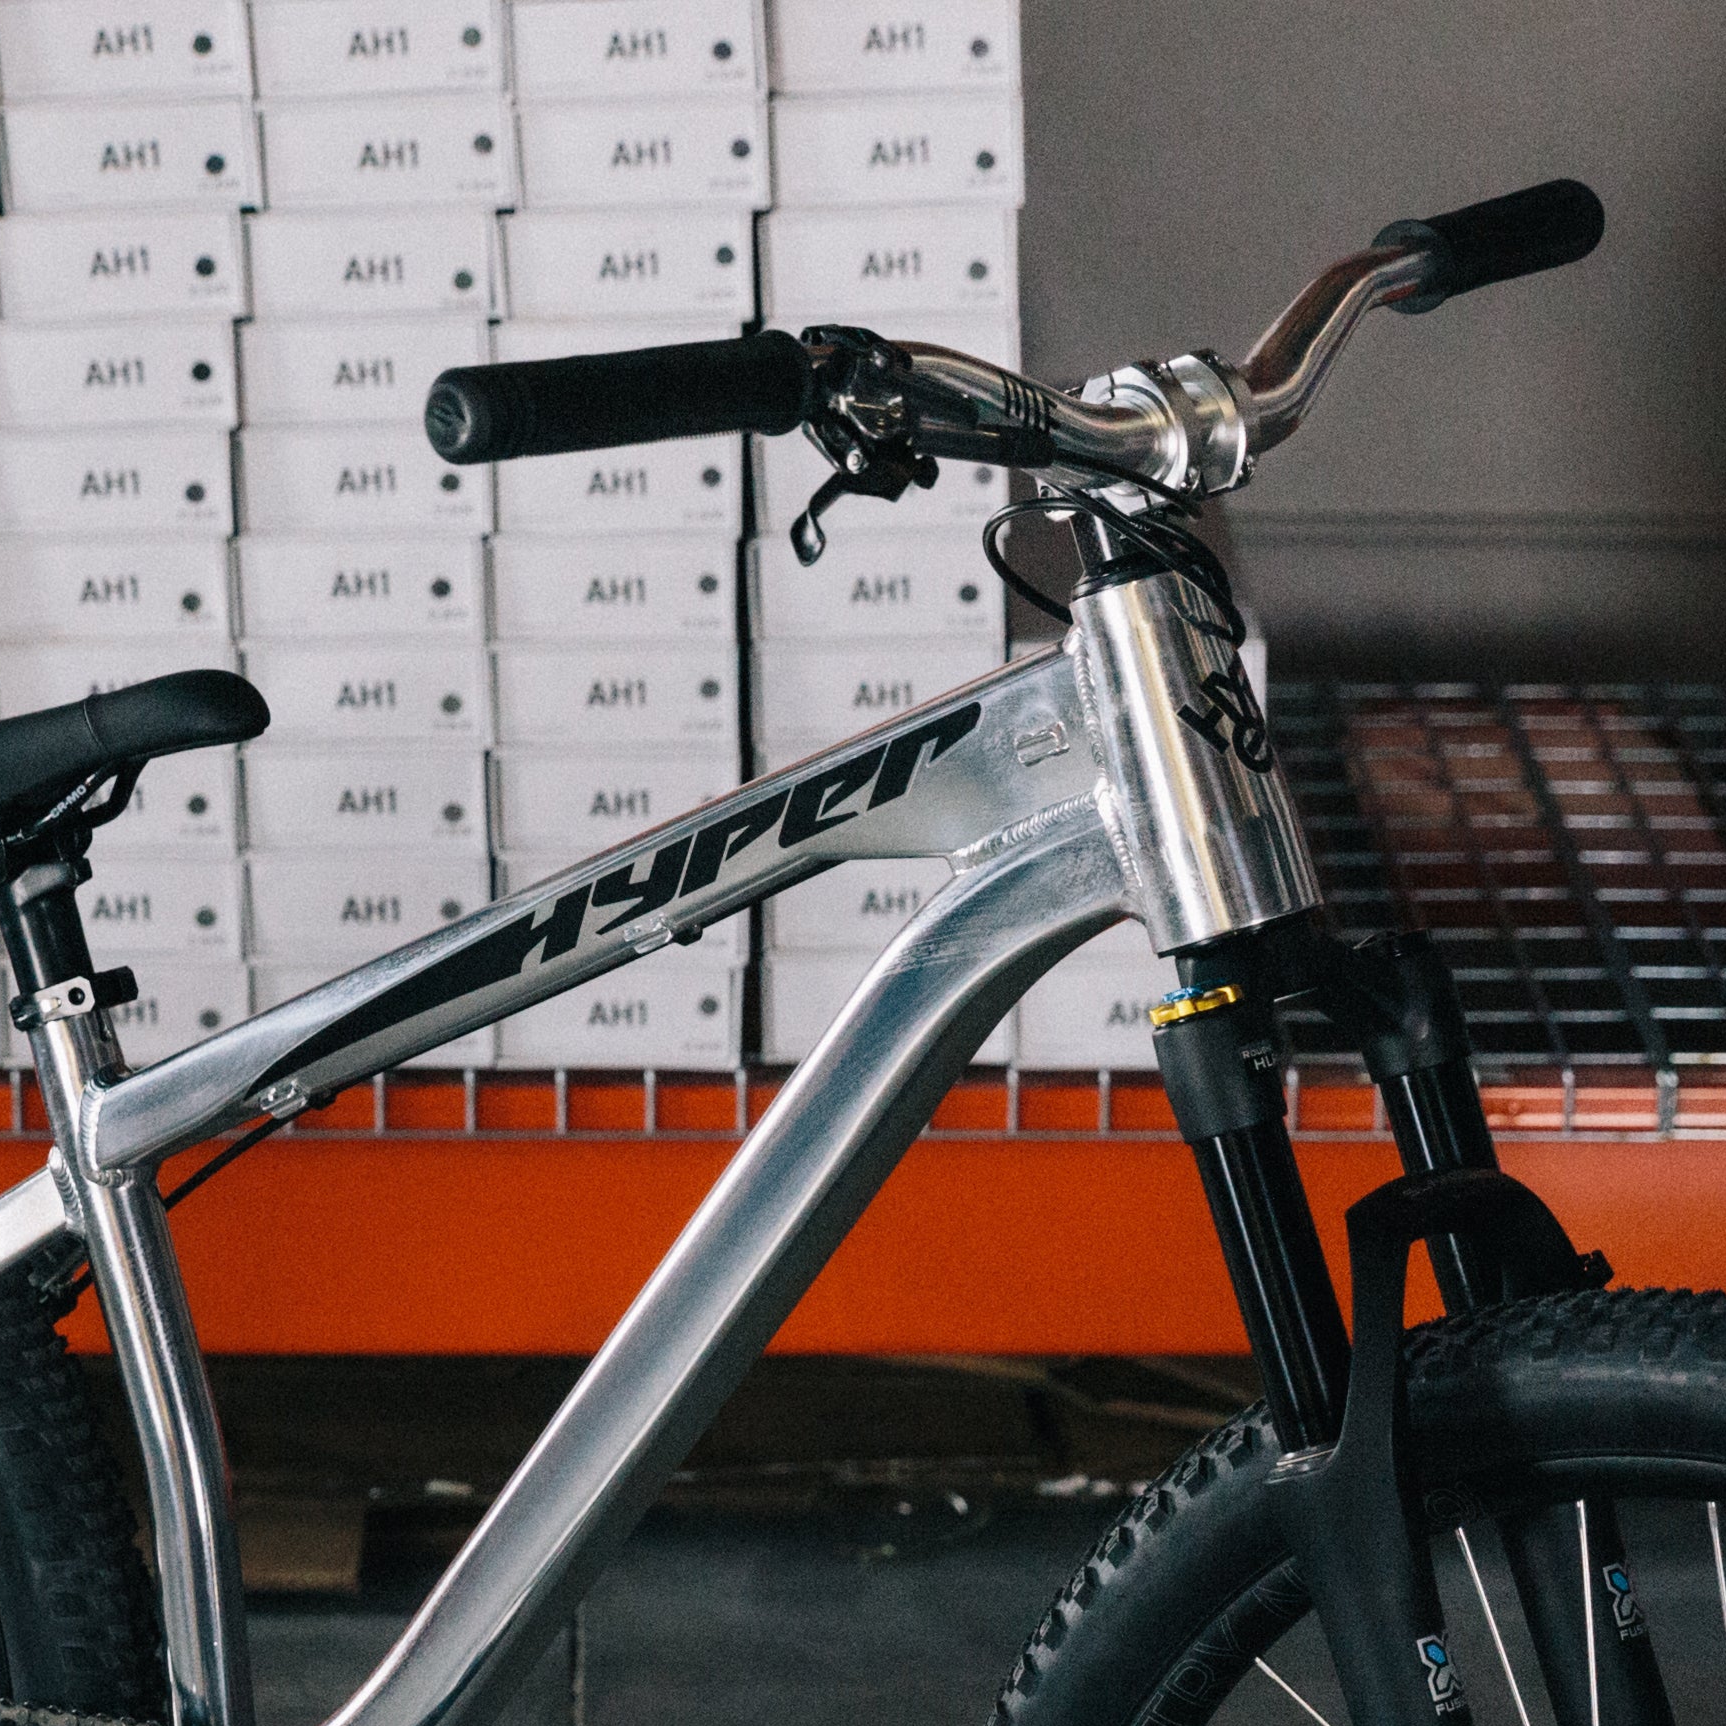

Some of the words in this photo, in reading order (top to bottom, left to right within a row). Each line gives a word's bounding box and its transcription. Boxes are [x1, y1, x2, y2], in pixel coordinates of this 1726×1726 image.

[92, 25, 153, 57] AH1
[348, 27, 409, 58] AH1
[606, 30, 667, 59] AH1
[863, 24, 924, 53] AH1
[100, 140, 161, 172] AH1
[358, 140, 419, 169] AH1
[610, 138, 672, 168] AH1
[868, 136, 929, 167] AH1
[89, 246, 150, 278] AH1
[342, 255, 404, 283] AH1
[598, 251, 659, 280] AH1
[861, 249, 922, 278] AH1
[84, 358, 145, 387] AH1
[334, 358, 394, 387] AH1
[80, 469, 140, 498] AH1
[336, 465, 396, 494] AH1
[586, 467, 647, 496] AH1
[79, 575, 139, 604] AH1
[331, 570, 390, 598] AH1
[585, 577, 646, 604] AH1
[850, 575, 911, 604] AH1
[336, 681, 397, 709] AH1
[586, 680, 647, 707] AH1
[854, 682, 914, 708] AH1
[50, 784, 86, 819] CR-MO
[337, 787, 398, 814] AH1
[590, 790, 650, 816] AH1
[92, 895, 151, 921] AH1
[340, 896, 401, 923] AH1
[106, 998, 159, 1024] H1
[587, 1001, 648, 1026] AH1
